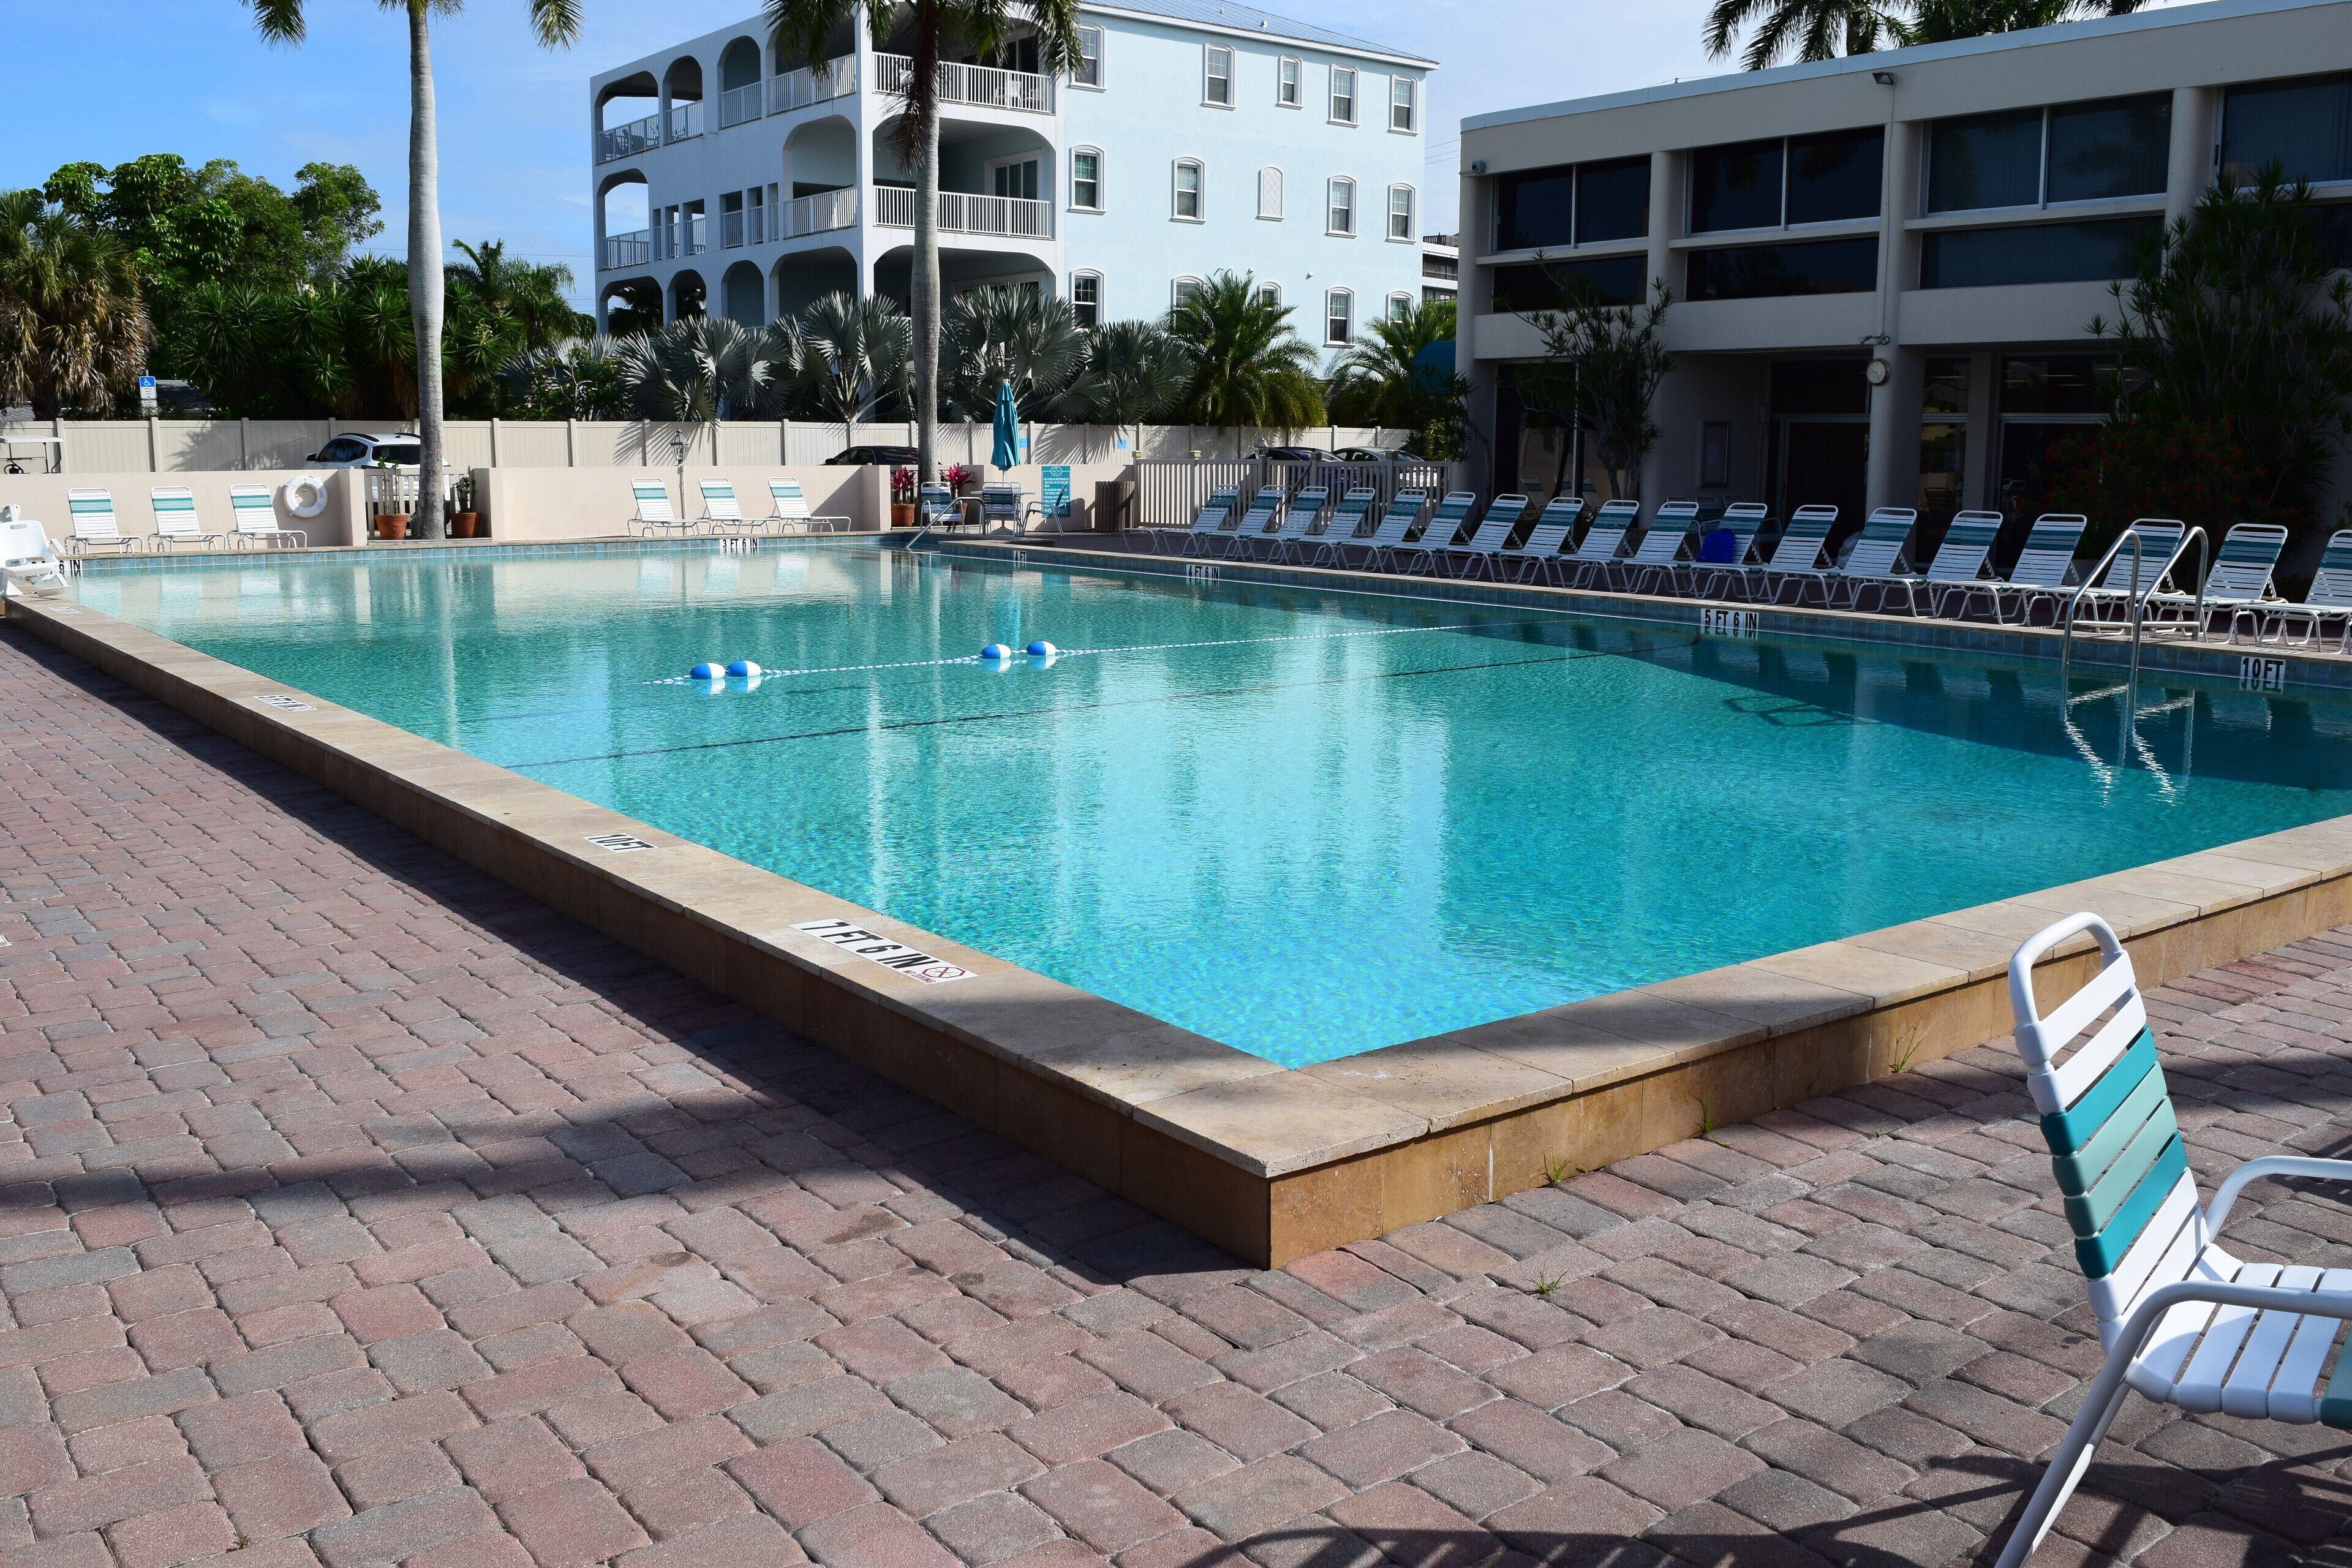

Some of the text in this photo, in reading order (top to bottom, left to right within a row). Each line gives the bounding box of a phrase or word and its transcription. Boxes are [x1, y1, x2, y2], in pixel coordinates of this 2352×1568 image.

[723, 538, 758, 548] 3 FT 6 IN
[1015, 551, 1027, 562] 4 FT
[59, 559, 80, 570] 6 IN
[1189, 565, 1219, 579] 4 FT 6 IN
[1705, 609, 1757, 630] 5 FT 6 IN
[800, 922, 940, 969] 7 FT 6 IN
